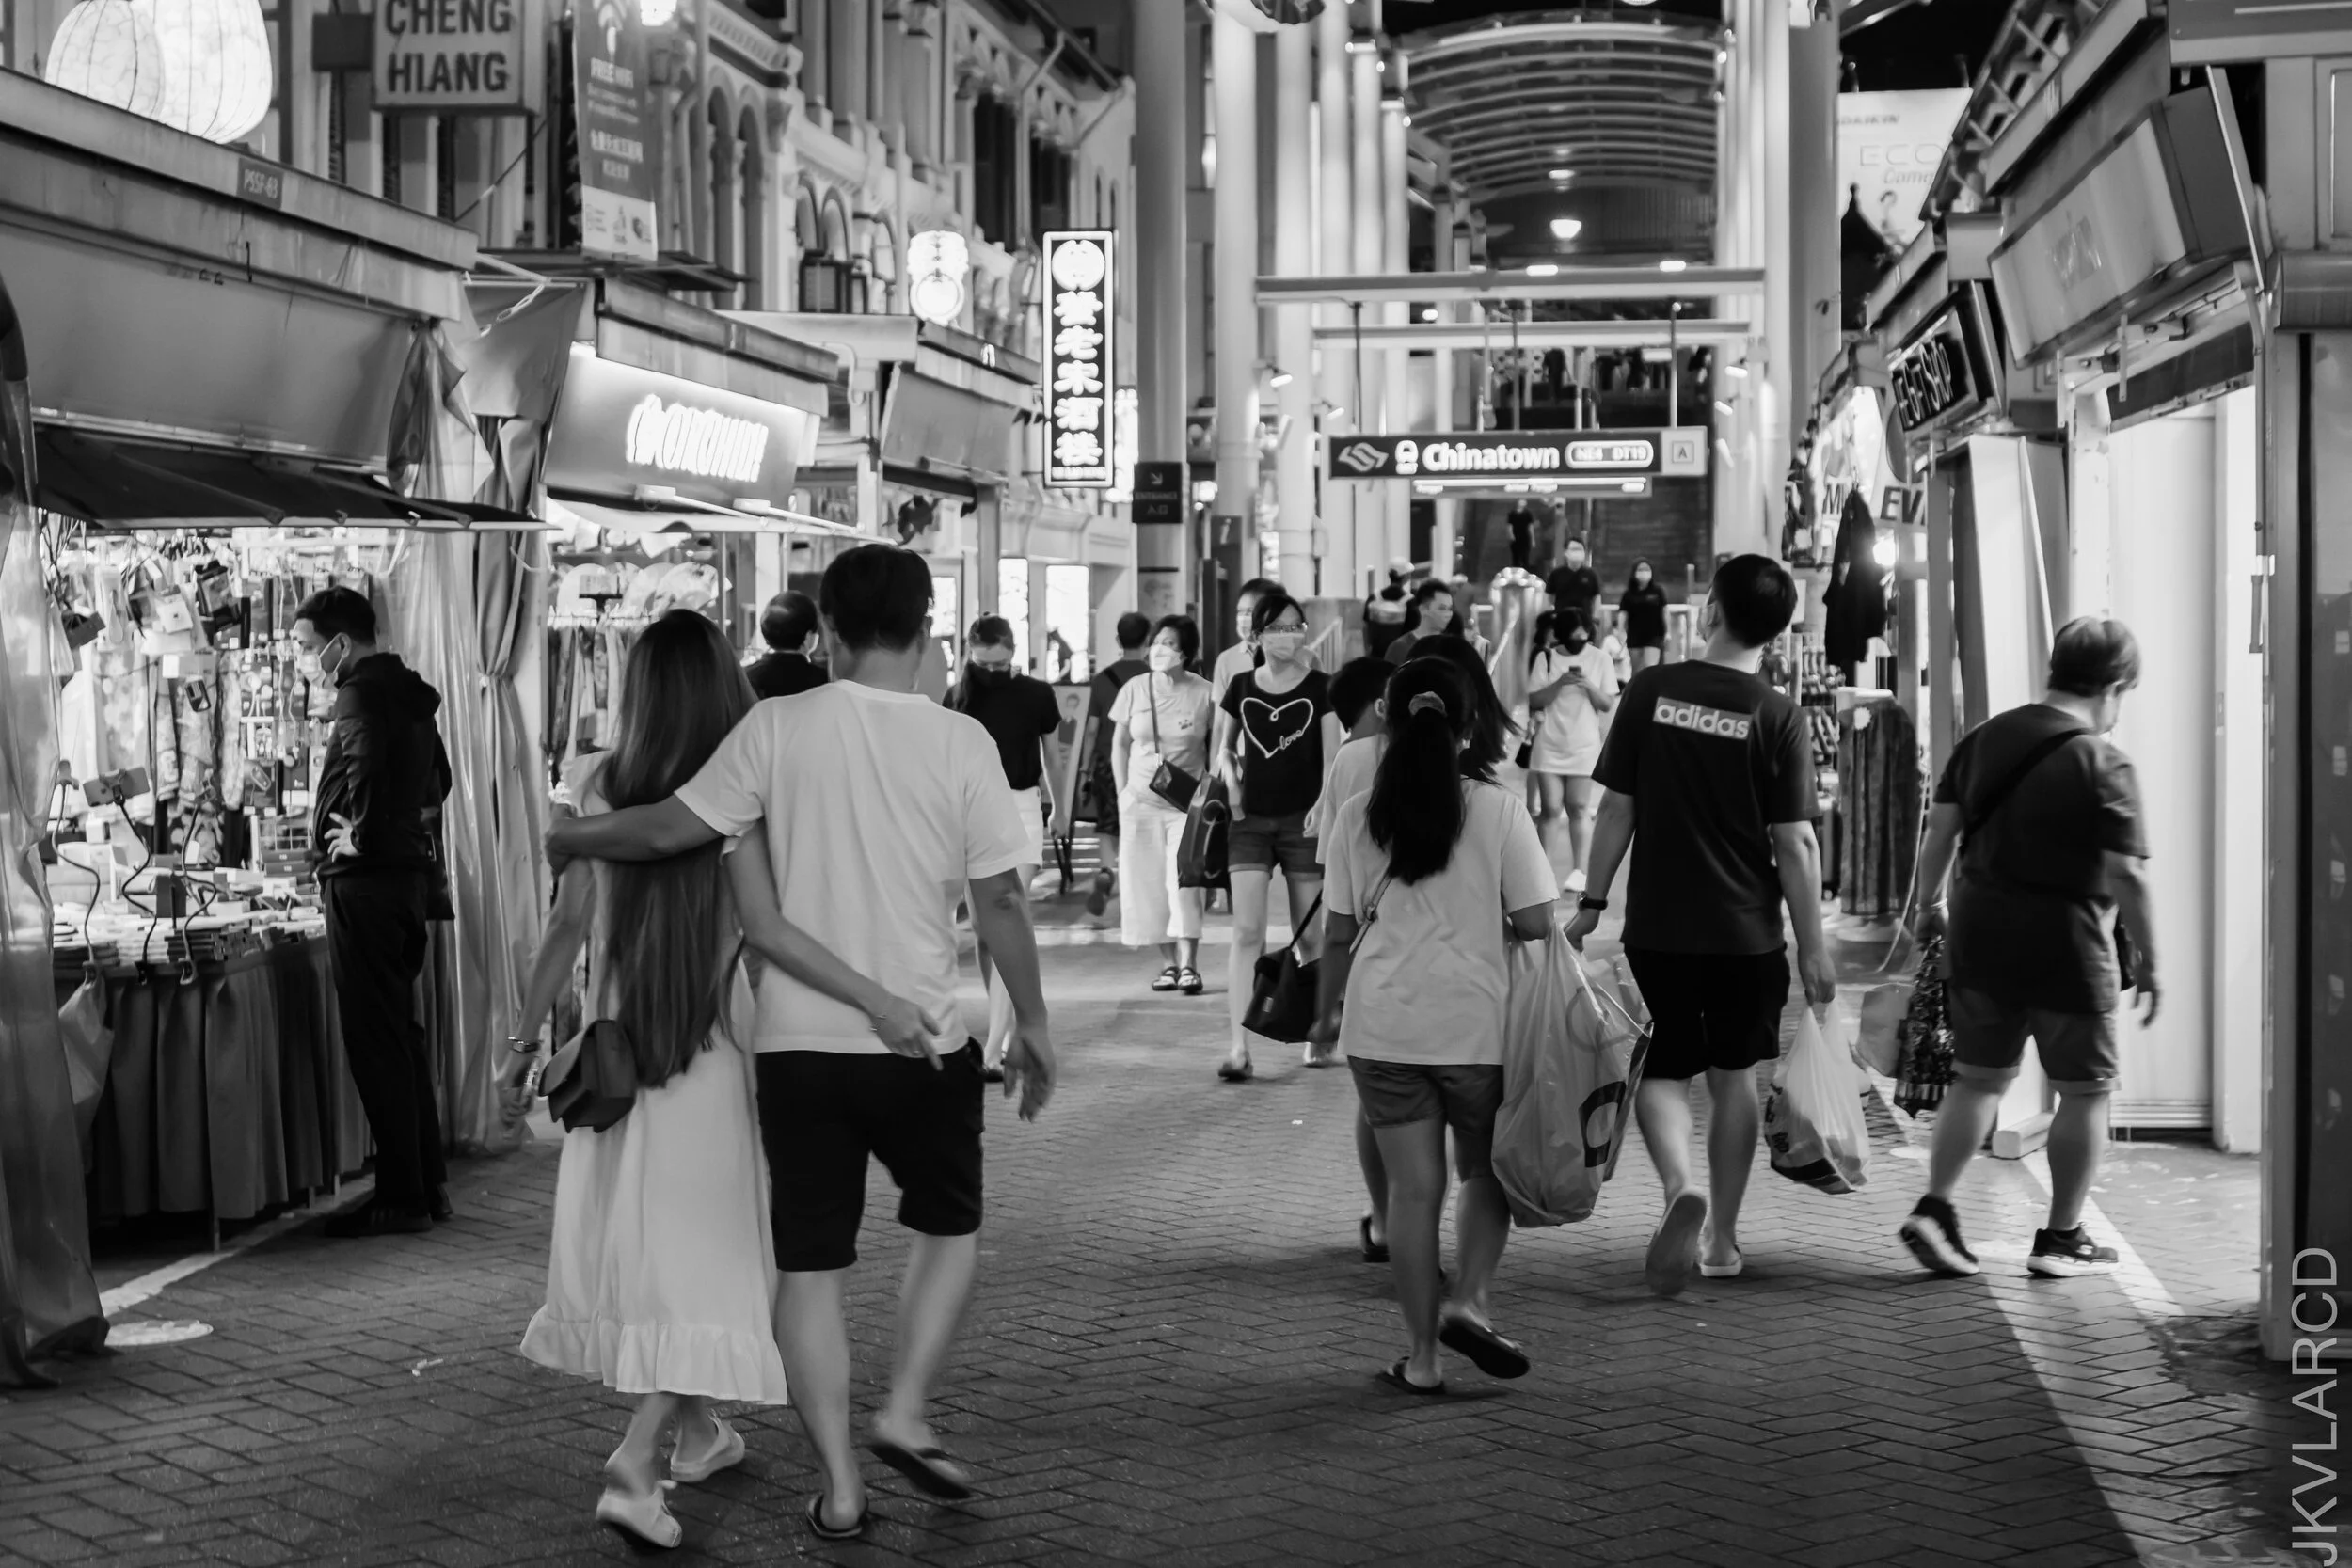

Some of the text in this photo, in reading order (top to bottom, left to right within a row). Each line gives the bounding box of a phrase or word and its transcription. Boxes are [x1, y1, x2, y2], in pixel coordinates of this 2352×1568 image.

[385, 0, 512, 35] CHENG
[388, 52, 509, 93] HIANG
[1422, 441, 1561, 471] Chinatown
[1656, 704, 1750, 739] adidas
